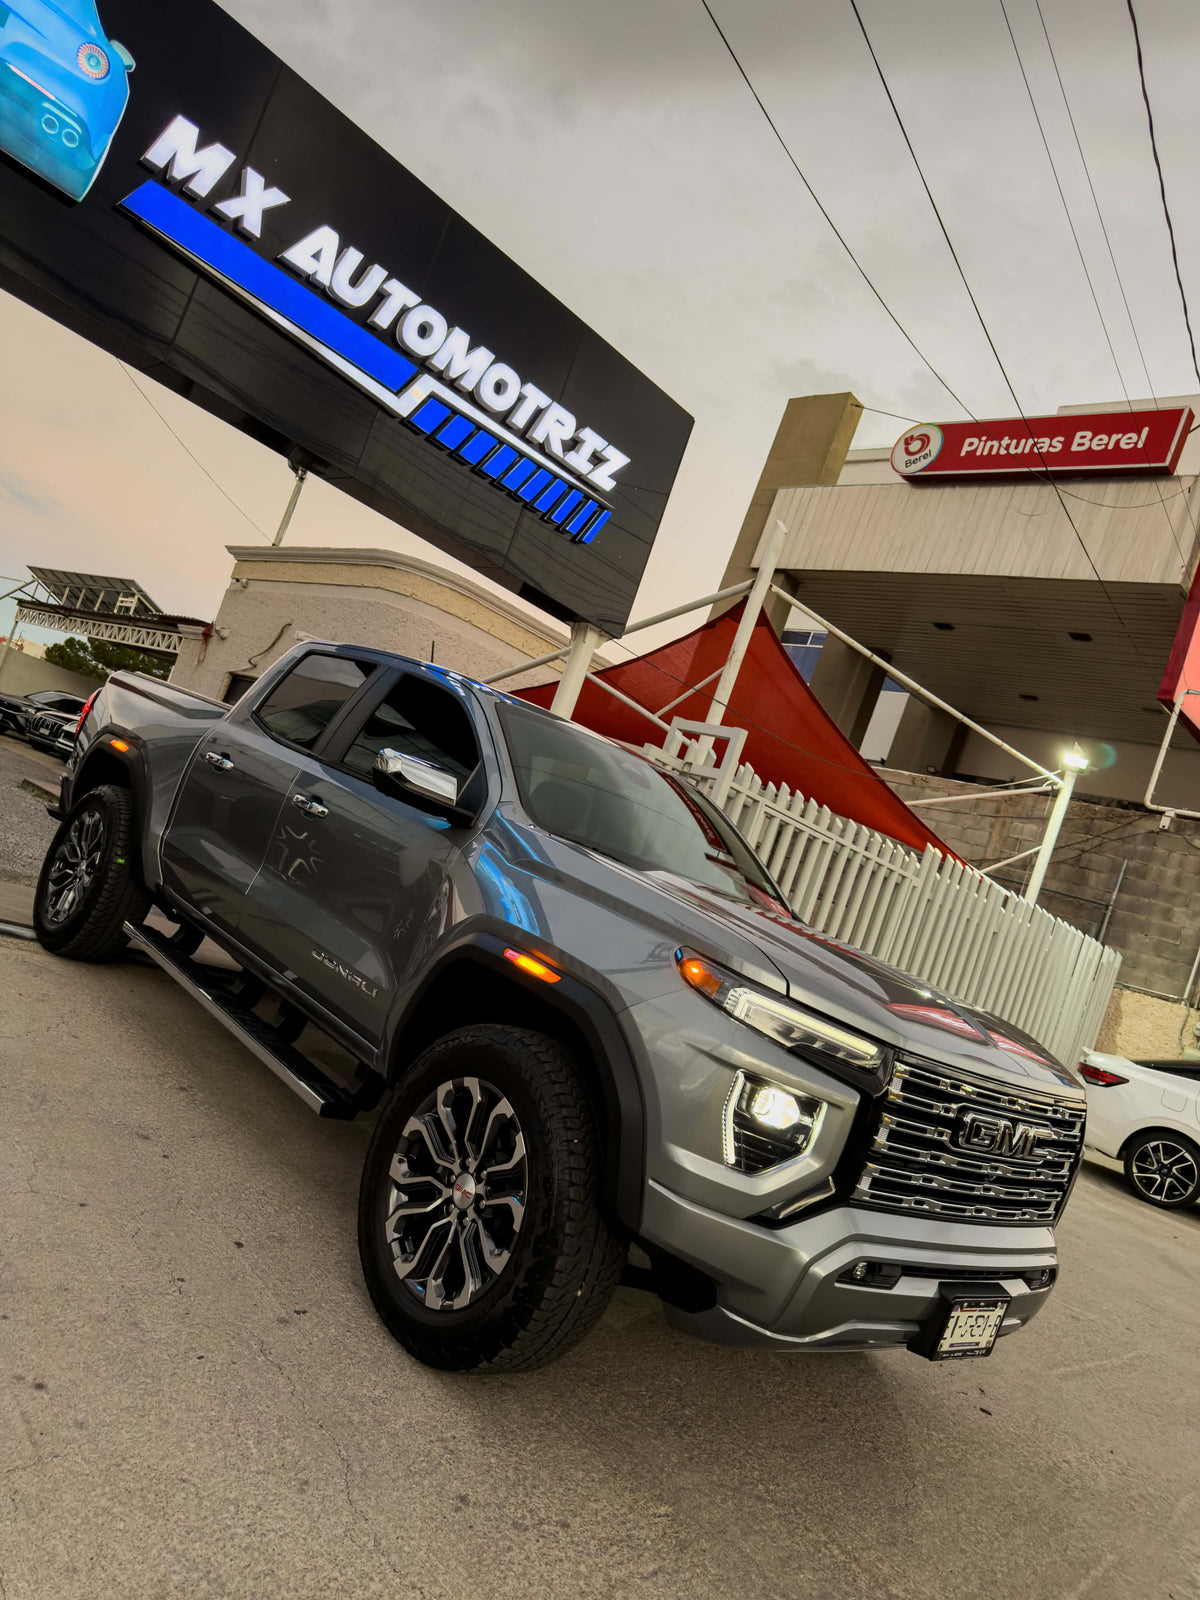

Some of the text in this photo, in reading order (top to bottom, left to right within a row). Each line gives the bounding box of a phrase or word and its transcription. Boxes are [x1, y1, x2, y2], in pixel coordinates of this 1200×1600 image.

[140, 114, 632, 493] MX AUTOMOTRIZ
[904, 449, 933, 469] Berel
[959, 426, 1150, 457] Pinturas Berel
[959, 1112, 1057, 1160] GMC
